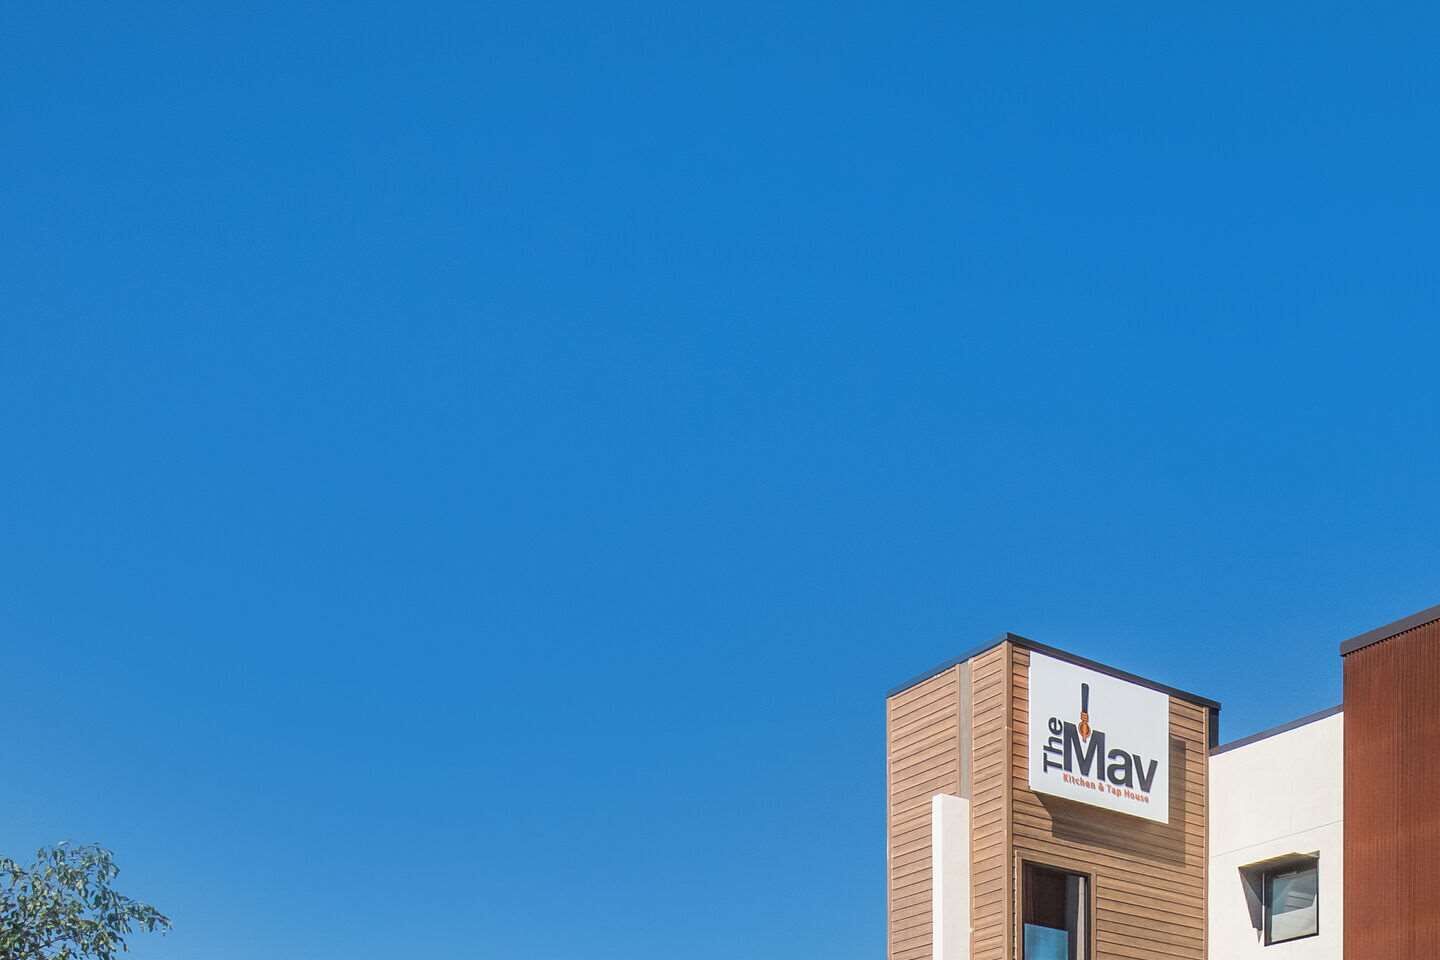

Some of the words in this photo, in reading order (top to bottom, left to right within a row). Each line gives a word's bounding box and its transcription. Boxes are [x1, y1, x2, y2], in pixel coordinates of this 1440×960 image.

[1043, 716, 1063, 773] The
[1063, 721, 1158, 793] Mav
[1063, 772, 1096, 790] Kitchen
[1107, 784, 1122, 798] Tap
[1124, 788, 1149, 803] House
